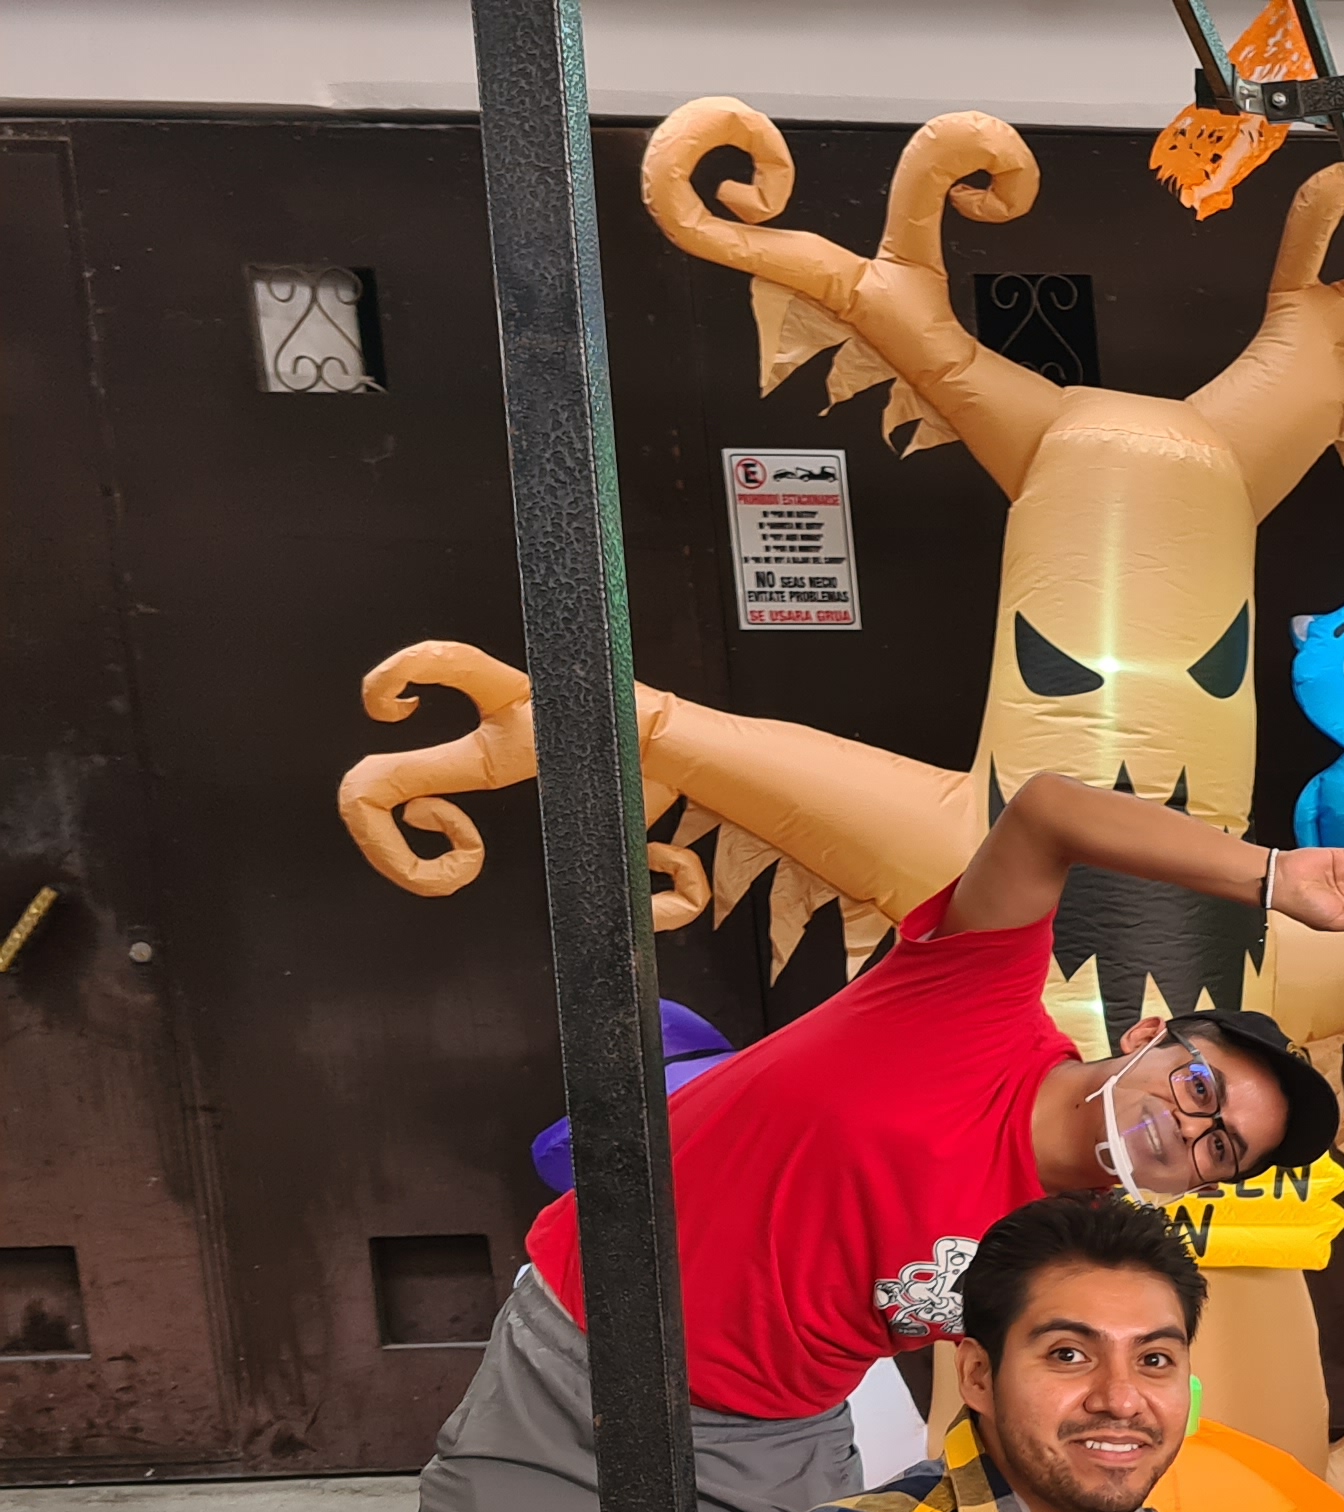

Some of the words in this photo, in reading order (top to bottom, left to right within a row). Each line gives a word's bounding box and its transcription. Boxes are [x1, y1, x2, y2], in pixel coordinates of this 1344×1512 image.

[755, 571, 776, 588] NO
[780, 576, 805, 588] SEAS
[809, 576, 838, 588] NECIO
[747, 591, 786, 602] EVITATE
[789, 591, 849, 602] PROBLEMAS
[749, 610, 765, 621] SE
[769, 610, 813, 621] USARA
[816, 610, 852, 621] GRUA
